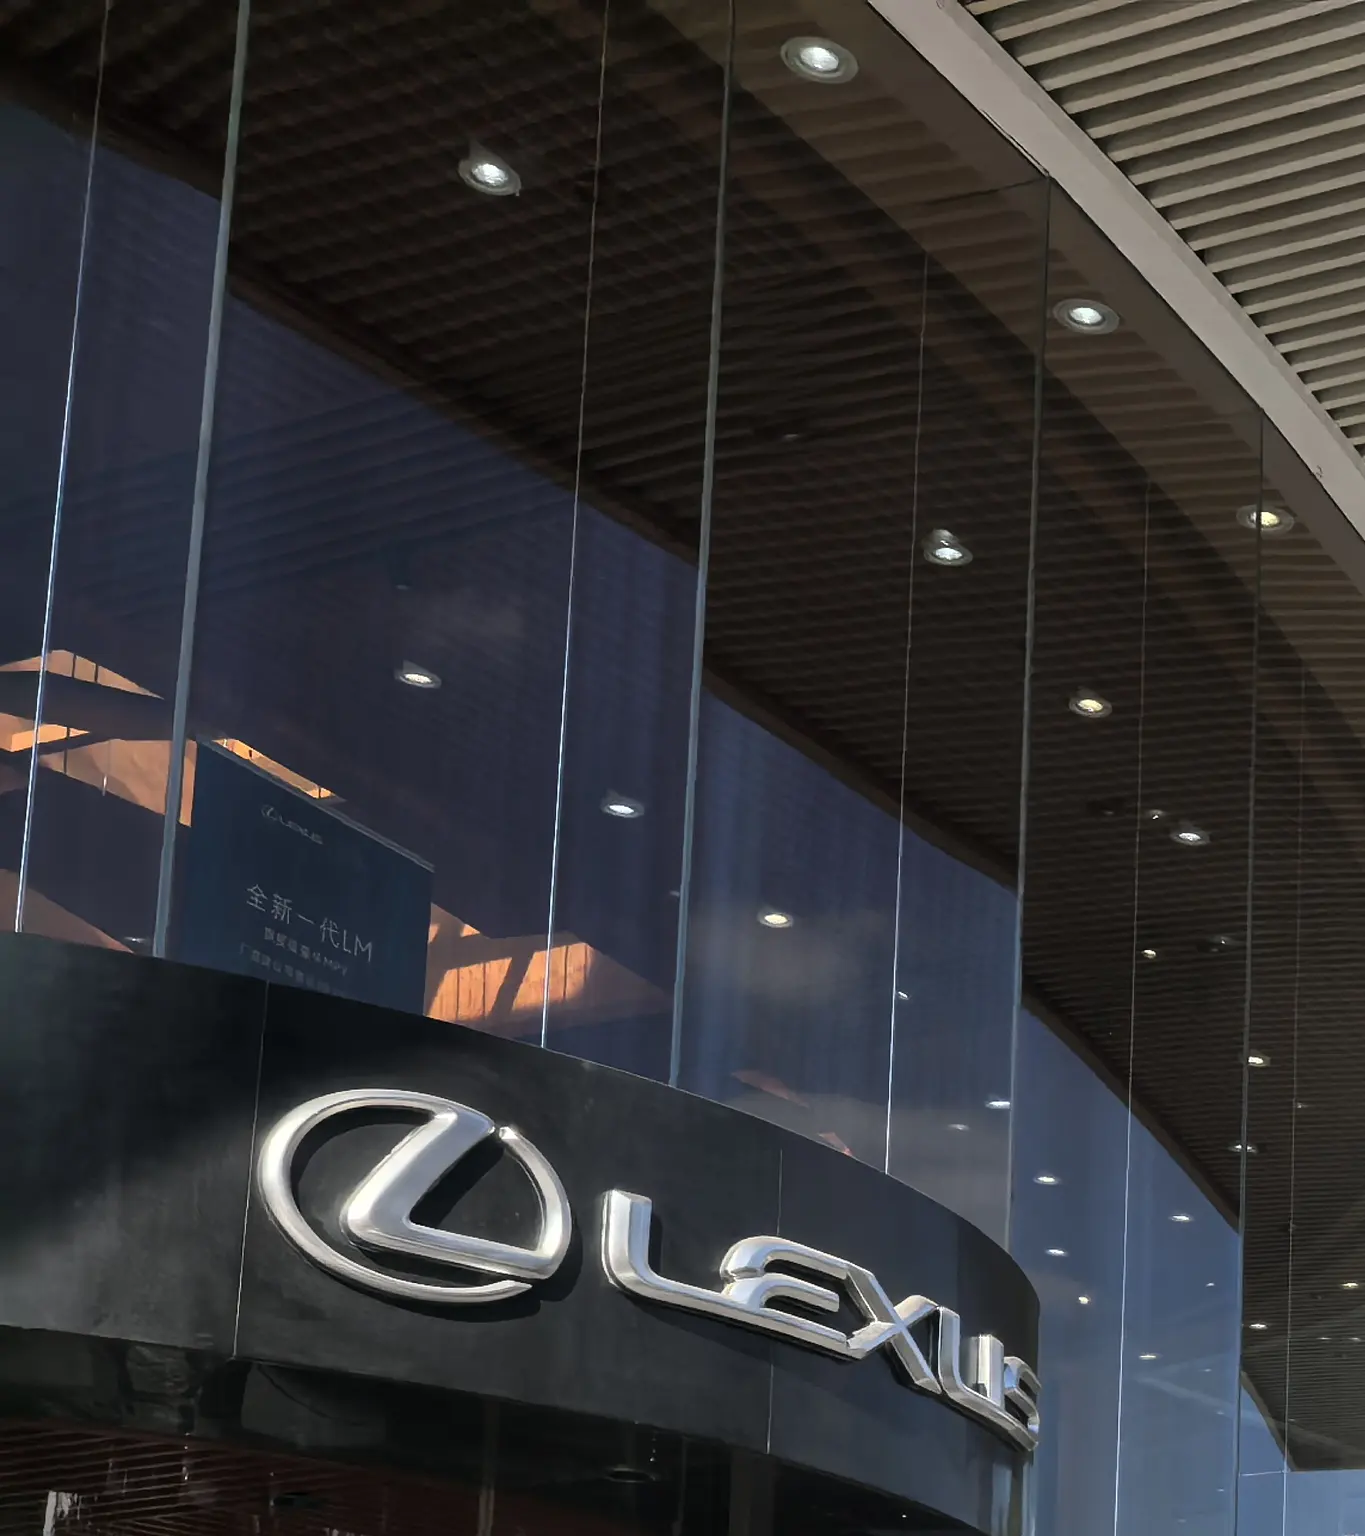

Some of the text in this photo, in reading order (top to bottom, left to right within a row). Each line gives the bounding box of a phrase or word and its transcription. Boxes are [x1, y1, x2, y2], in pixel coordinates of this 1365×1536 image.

[246, 883, 373, 963] 全新一代LM
[601, 1188, 1041, 1452] LEXUS
